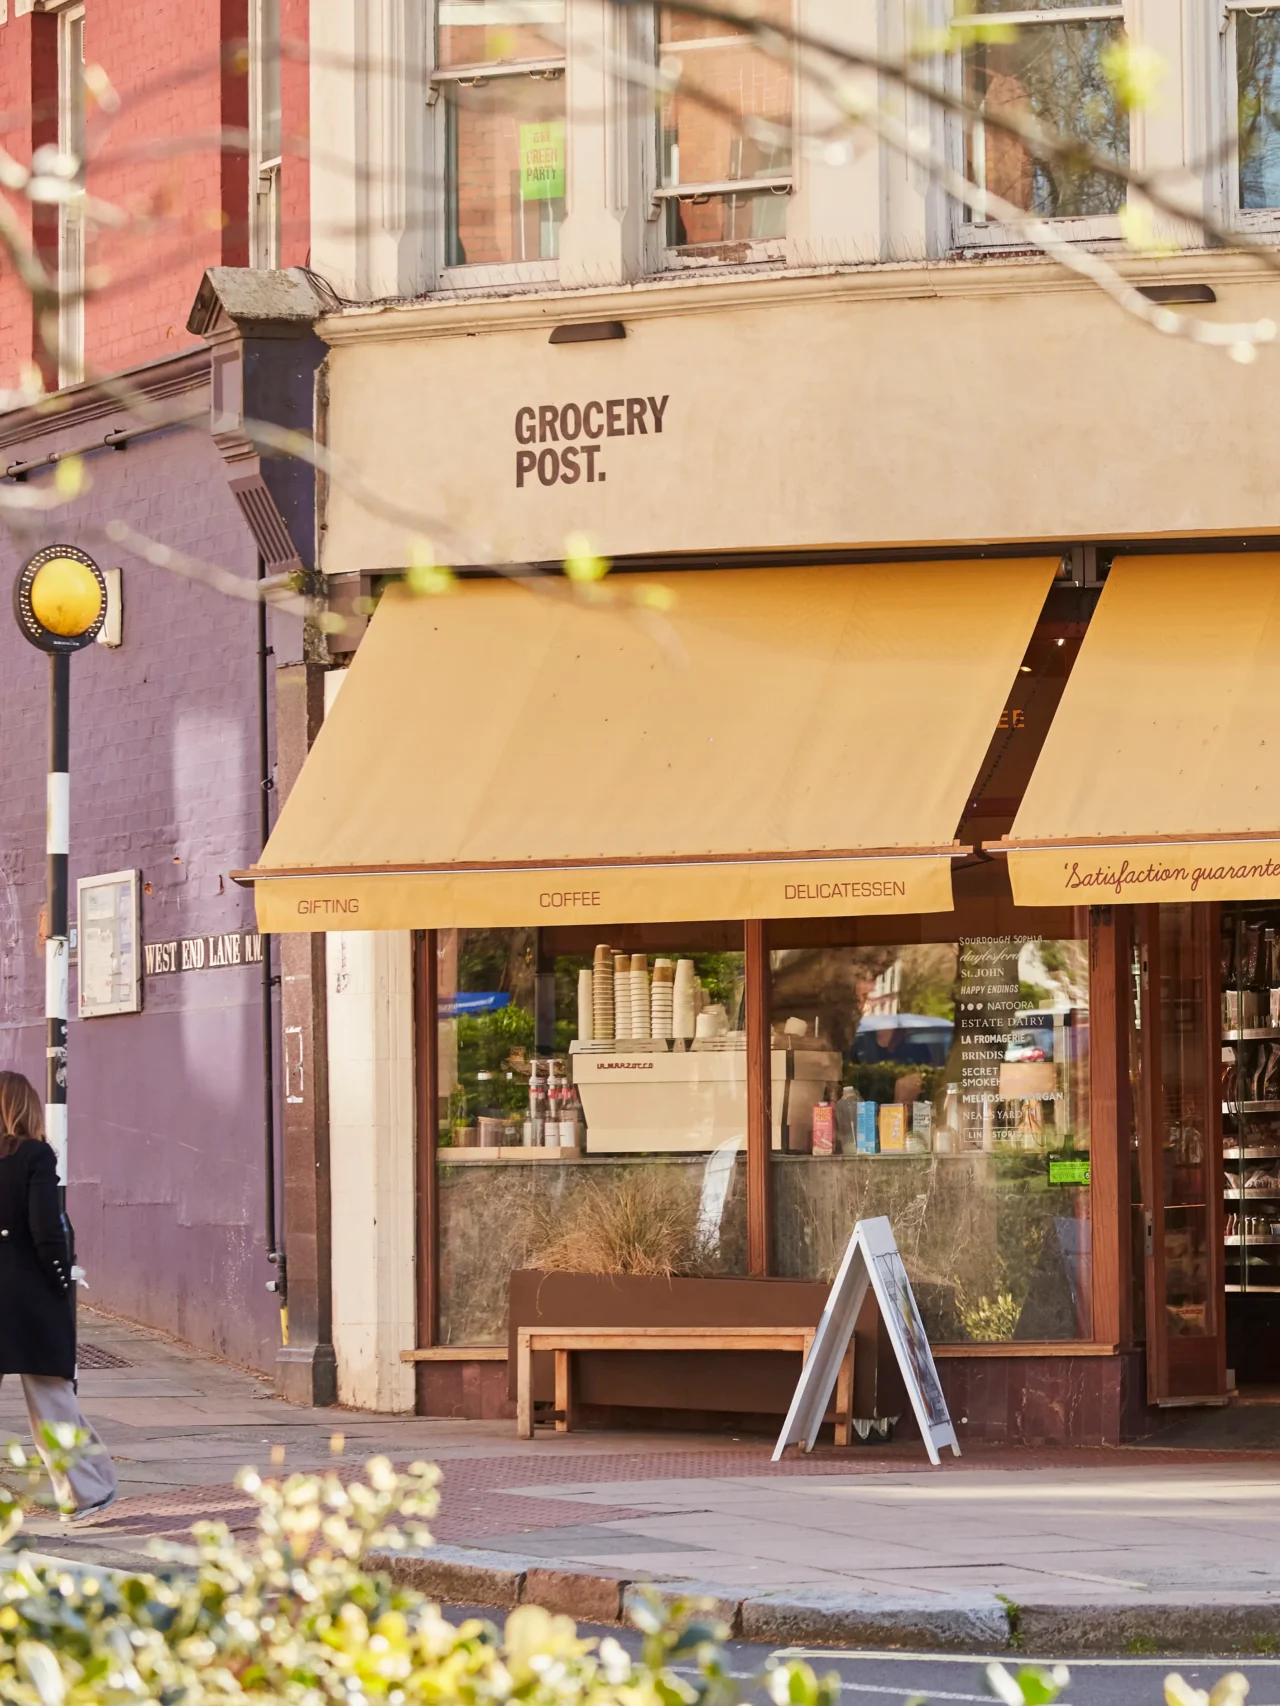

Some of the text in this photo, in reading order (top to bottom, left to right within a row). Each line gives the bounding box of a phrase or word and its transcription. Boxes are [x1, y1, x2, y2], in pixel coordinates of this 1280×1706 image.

[526, 167, 557, 182] PARTY
[515, 395, 670, 445] GROCERY
[516, 445, 606, 488] POST.
[784, 881, 905, 900] DELICATESSEN
[539, 891, 601, 908] COFFEE
[297, 898, 359, 914] GIFTING
[960, 936, 1010, 946] SOURDOUGH
[145, 941, 177, 975] WEST
[182, 938, 205, 970] END
[208, 934, 241, 967] LANE
[975, 968, 1005, 978] JOHN
[961, 984, 1019, 995] HAPPY ENDINGS
[987, 1001, 1034, 1011] NATOORA
[961, 1016, 1045, 1028] ESTATE DAIRY
[961, 1033, 1026, 1044] LA FROMAGERIE
[962, 1051, 1006, 1061] BRINDIS
[962, 1067, 998, 1076] SECRET
[997, 1110, 1023, 1119] YARD
